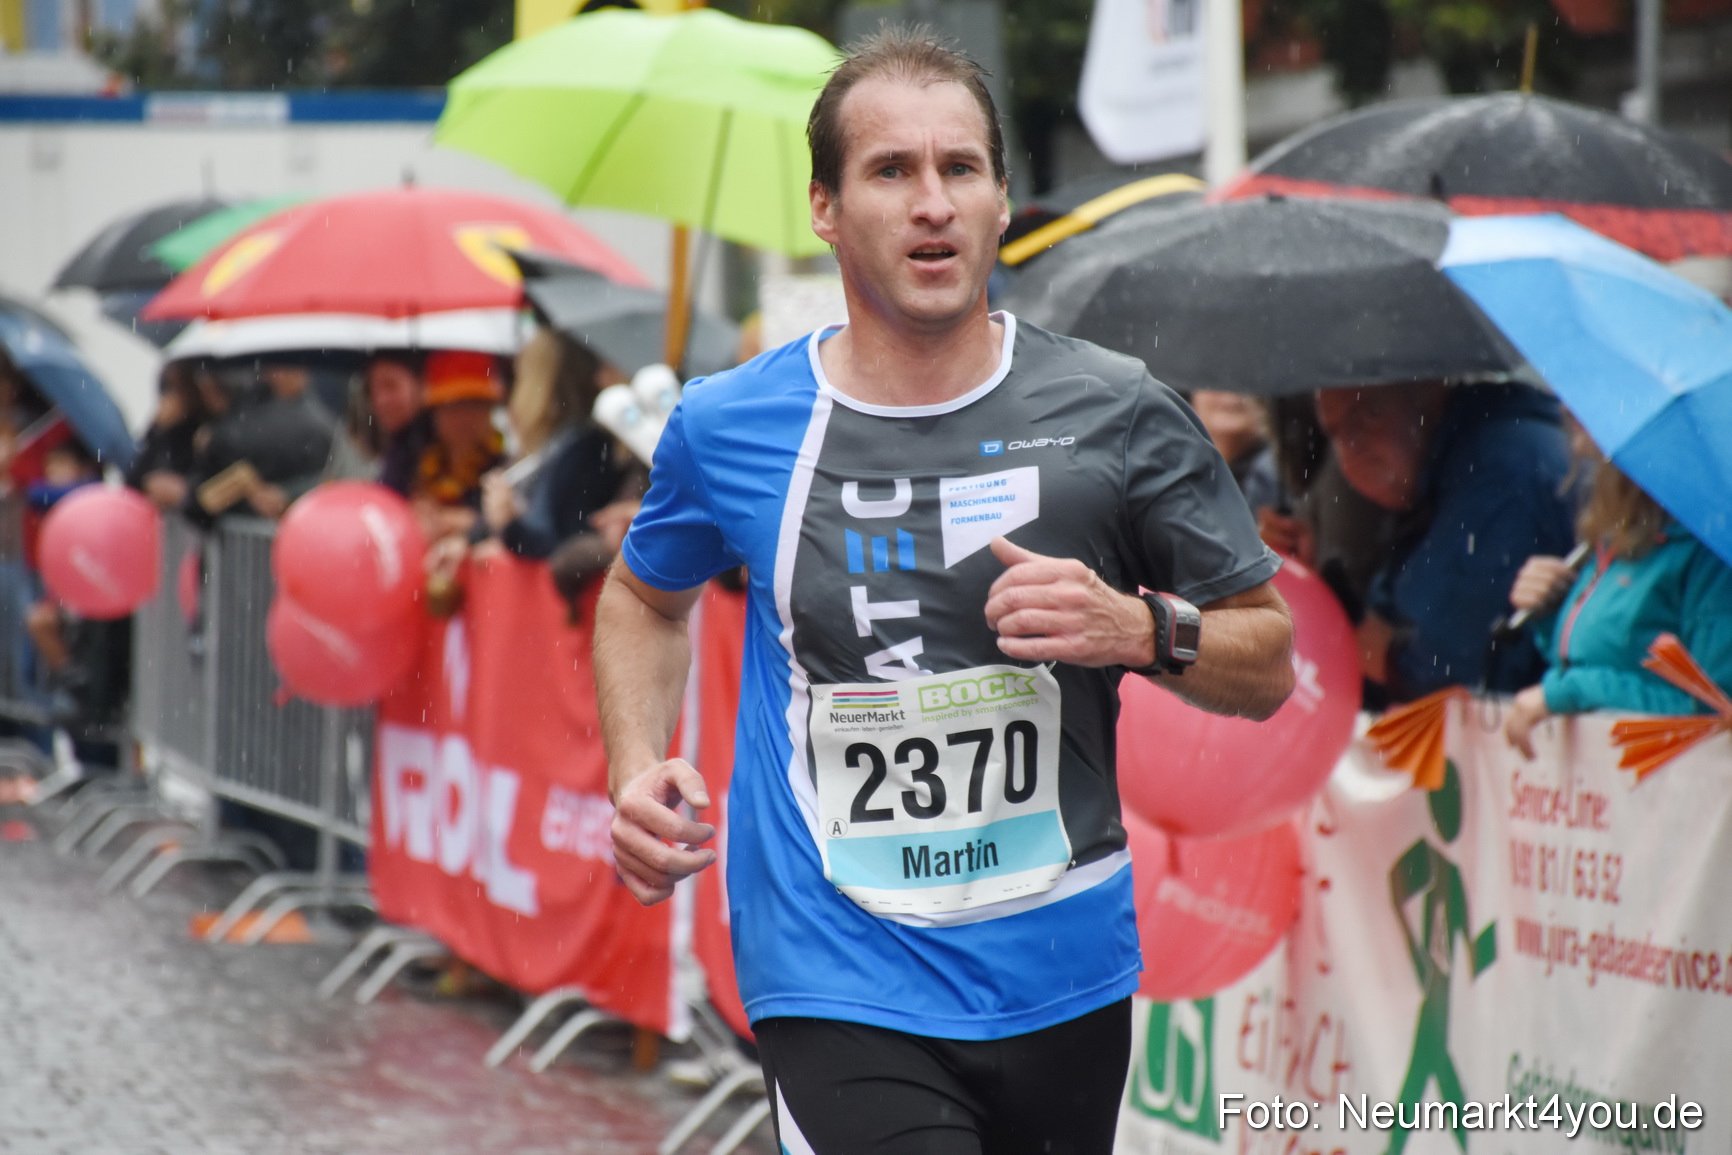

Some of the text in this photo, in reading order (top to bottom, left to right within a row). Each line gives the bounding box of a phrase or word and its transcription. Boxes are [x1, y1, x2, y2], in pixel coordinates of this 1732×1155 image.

[949, 494, 1016, 509] MASCHINENBAU
[950, 512, 1003, 525] FORMENBAU
[917, 673, 1038, 713] BOCK
[829, 709, 906, 724] NeuerMarkt
[921, 697, 1040, 723] inspired by smart concepts
[844, 719, 1039, 824] 2370
[831, 820, 843, 836] A
[901, 839, 1000, 880] Martin
